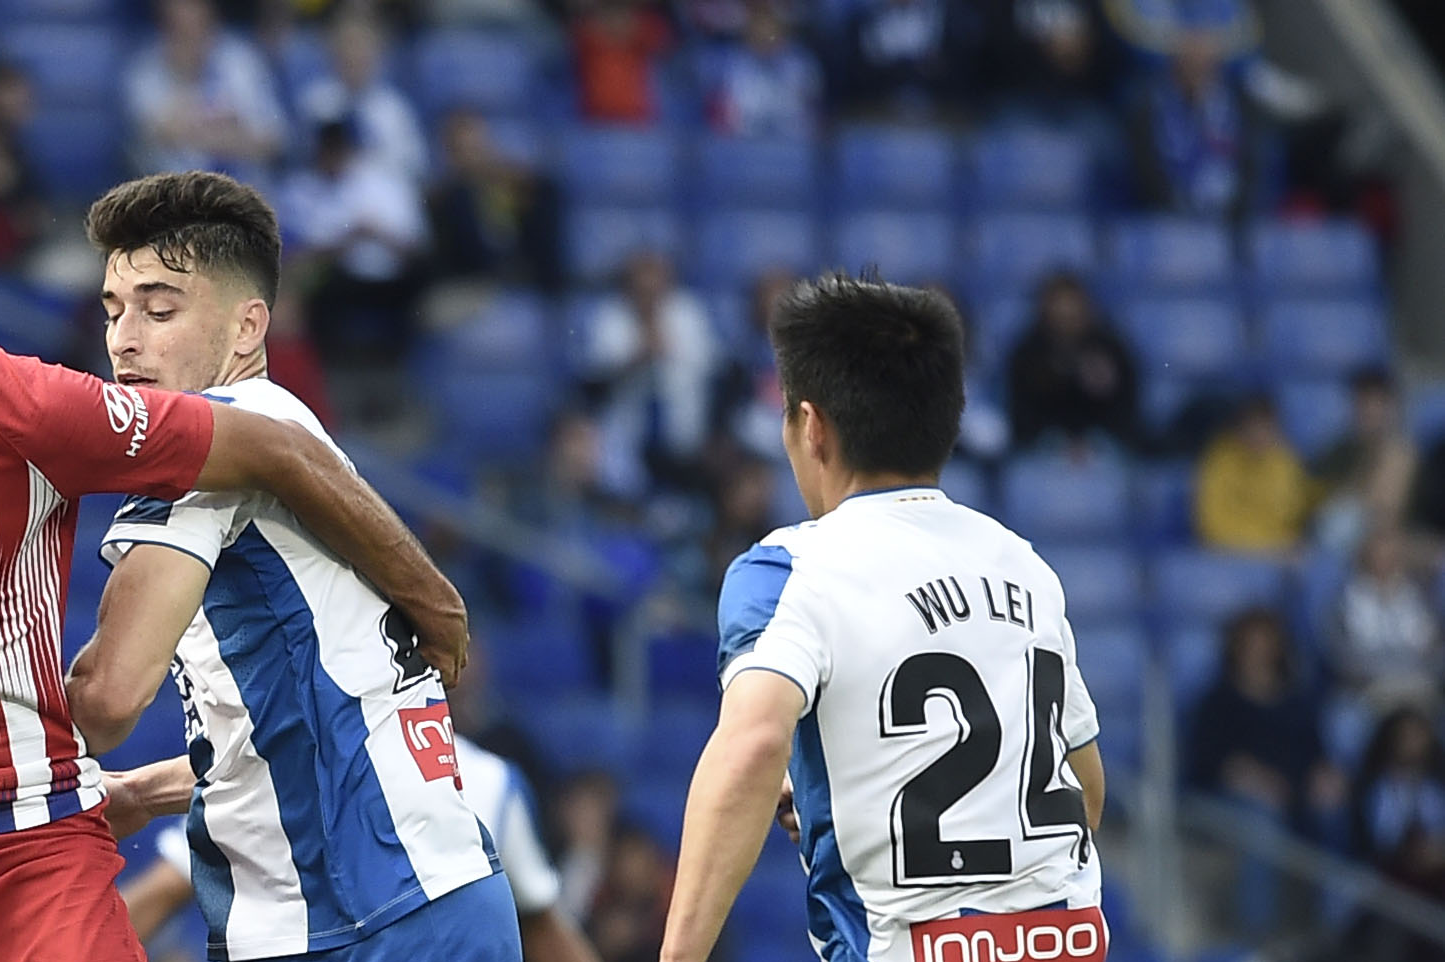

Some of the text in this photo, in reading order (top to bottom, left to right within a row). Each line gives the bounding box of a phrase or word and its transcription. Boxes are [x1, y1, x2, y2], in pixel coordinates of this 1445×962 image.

[904, 576, 1035, 635] WU LEI
[879, 647, 1091, 888] 24
